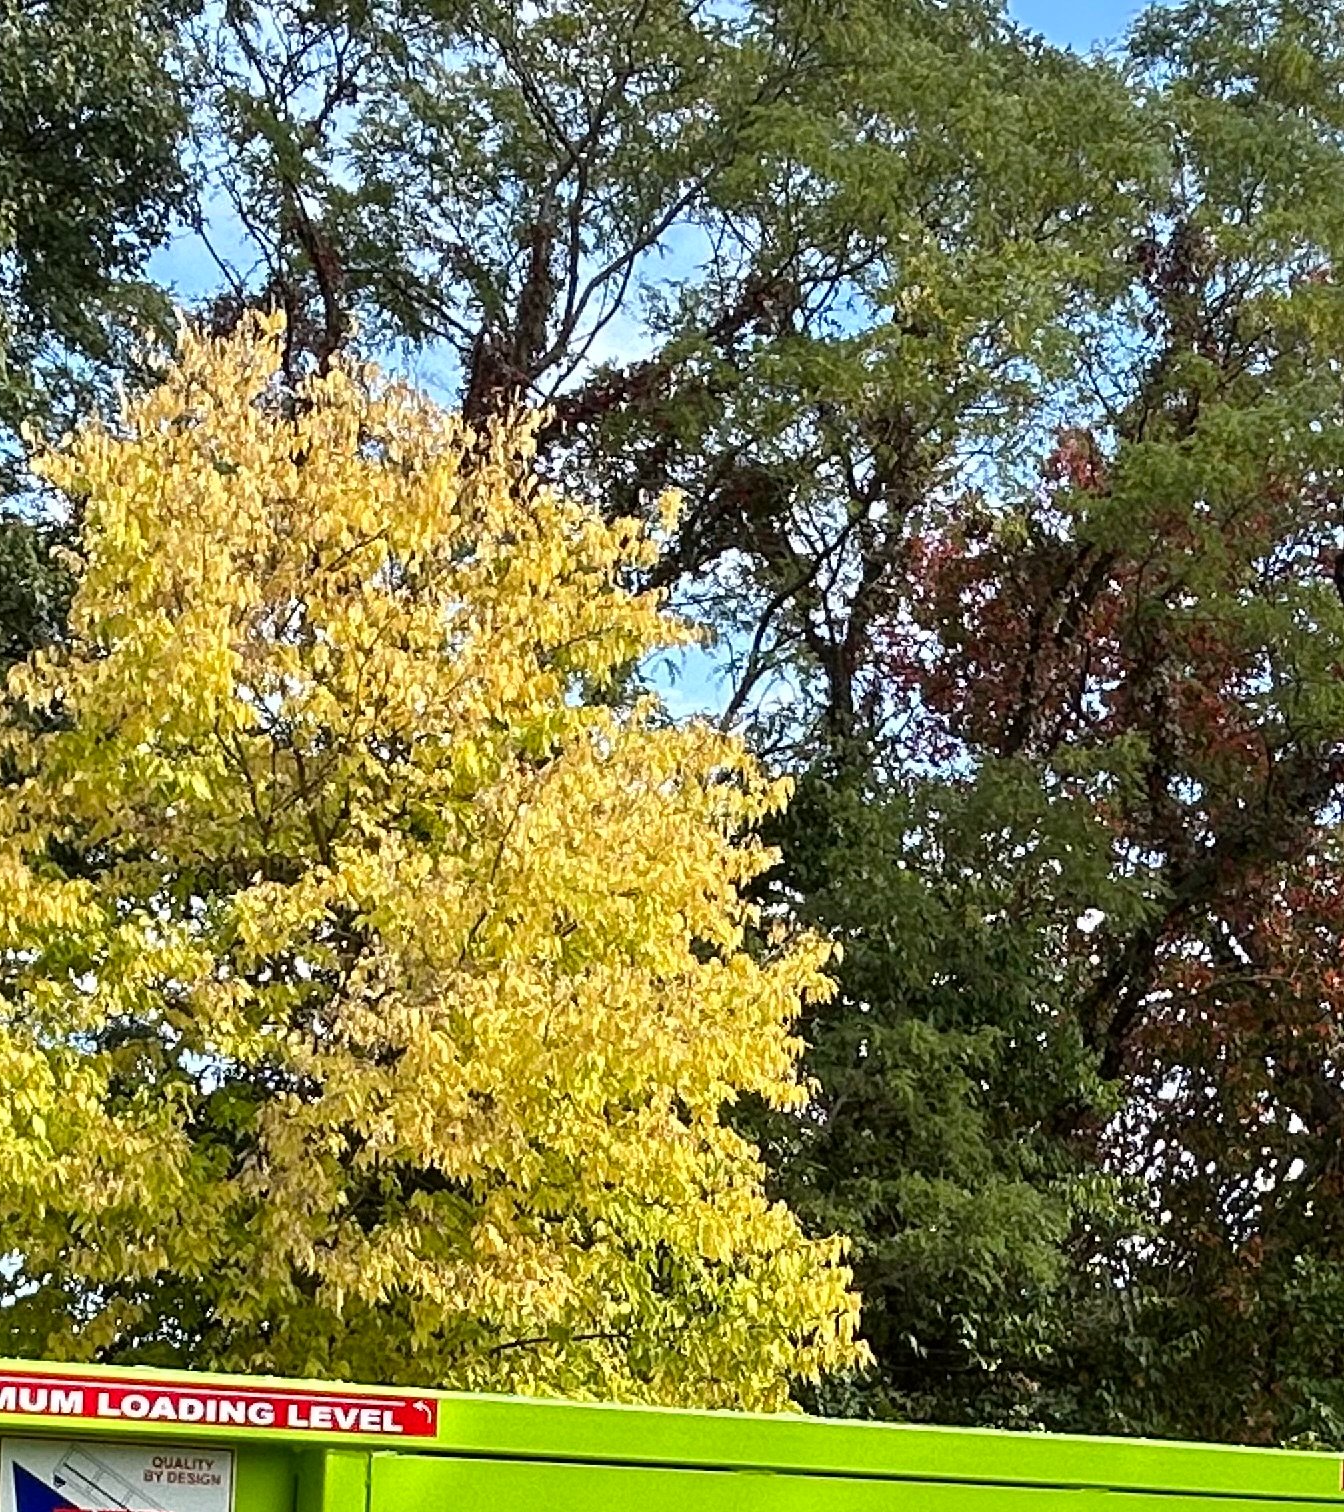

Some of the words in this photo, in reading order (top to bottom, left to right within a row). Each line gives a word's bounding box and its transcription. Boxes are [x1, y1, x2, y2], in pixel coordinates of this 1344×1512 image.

[97, 1391, 275, 1427] LOADING
[287, 1404, 403, 1432] LEVEL
[152, 1456, 215, 1470] QUALITY
[143, 1469, 163, 1483] BY
[167, 1471, 221, 1486] DESIGN
